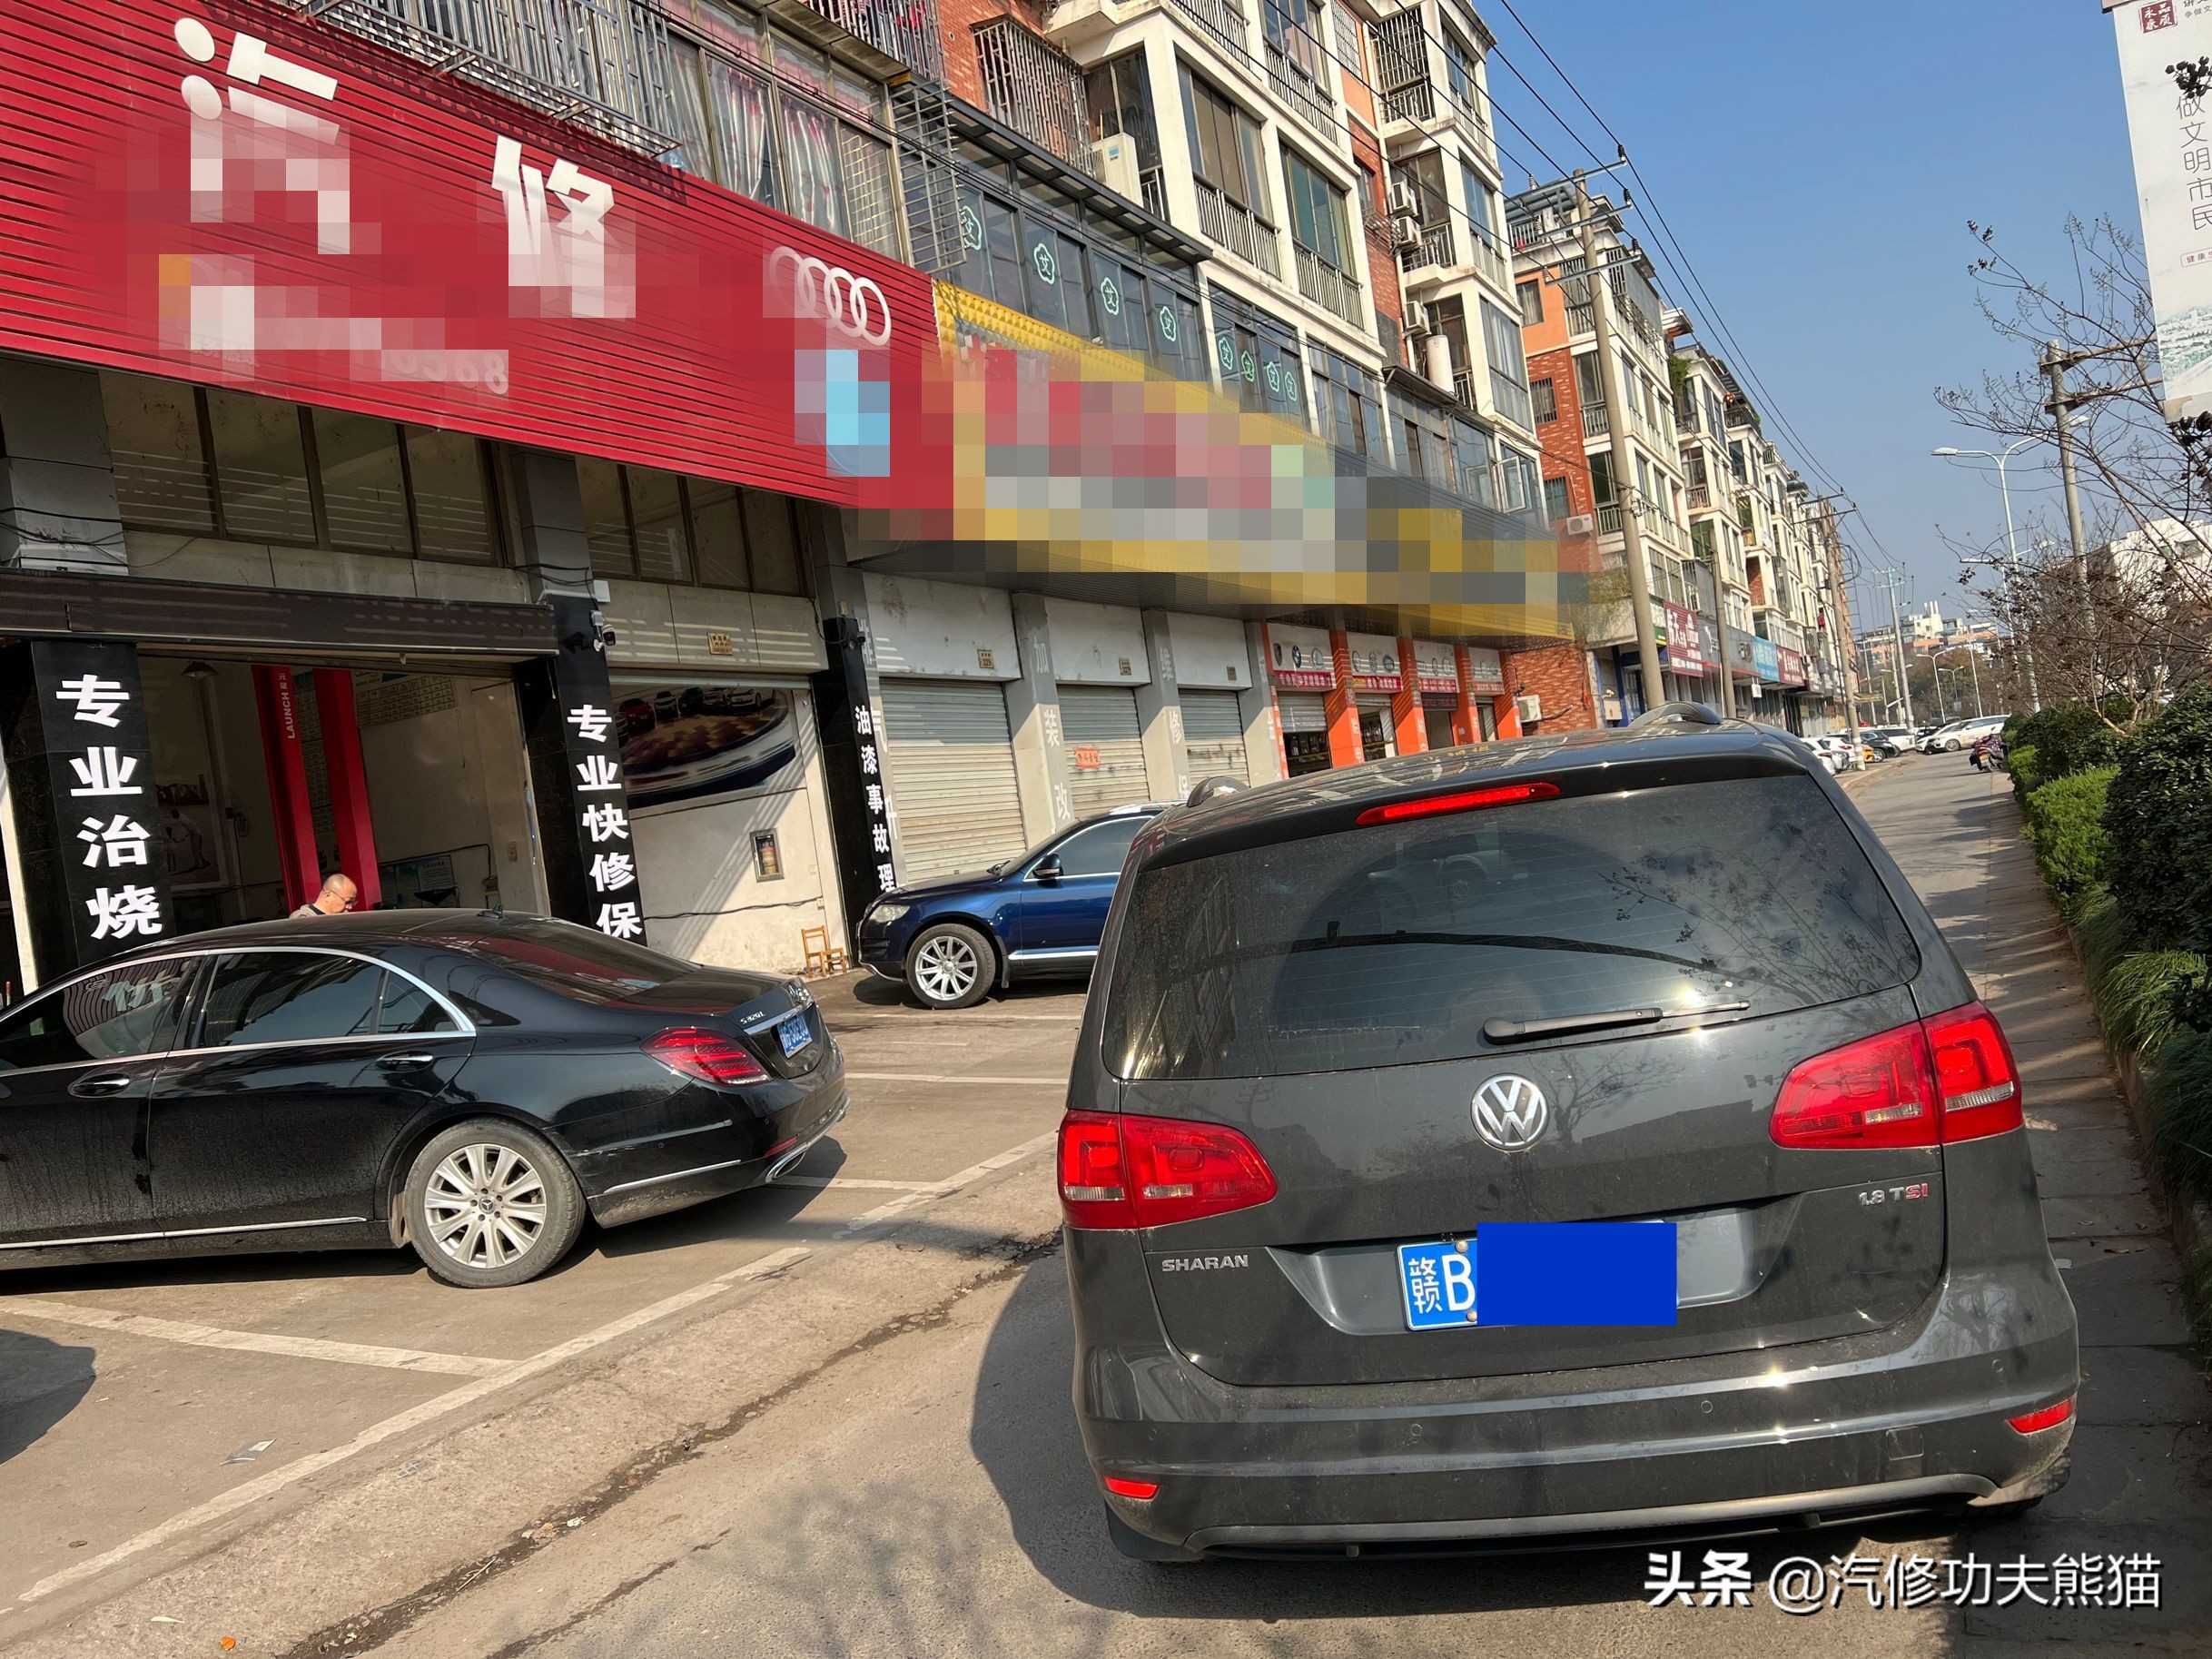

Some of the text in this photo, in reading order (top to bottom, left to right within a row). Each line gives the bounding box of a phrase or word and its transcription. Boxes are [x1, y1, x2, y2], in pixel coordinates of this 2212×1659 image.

[281, 691, 296, 739] LAUNCH
[567, 704, 643, 939] 专业快修保
[1859, 1183, 1929, 1206] 1.8 TSI
[1162, 1254, 1249, 1272] SHARAN
